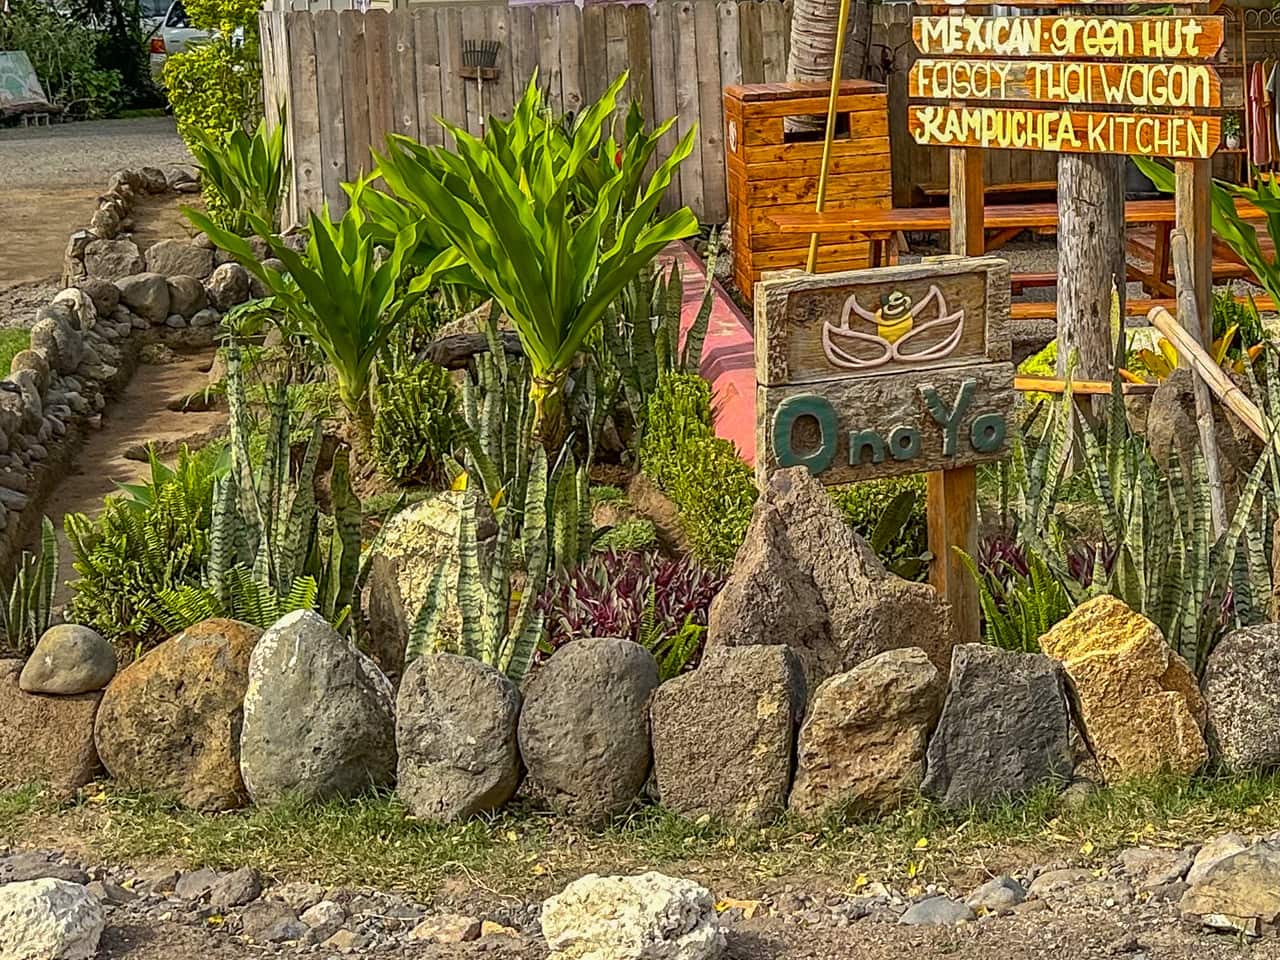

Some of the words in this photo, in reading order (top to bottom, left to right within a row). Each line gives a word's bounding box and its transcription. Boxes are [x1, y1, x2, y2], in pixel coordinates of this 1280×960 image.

[921, 16, 1041, 56] MEXICAN
[1051, 17, 1134, 57] green
[914, 105, 1082, 151] KAMPUCHEA
[1088, 114, 1208, 156] KITCHEN
